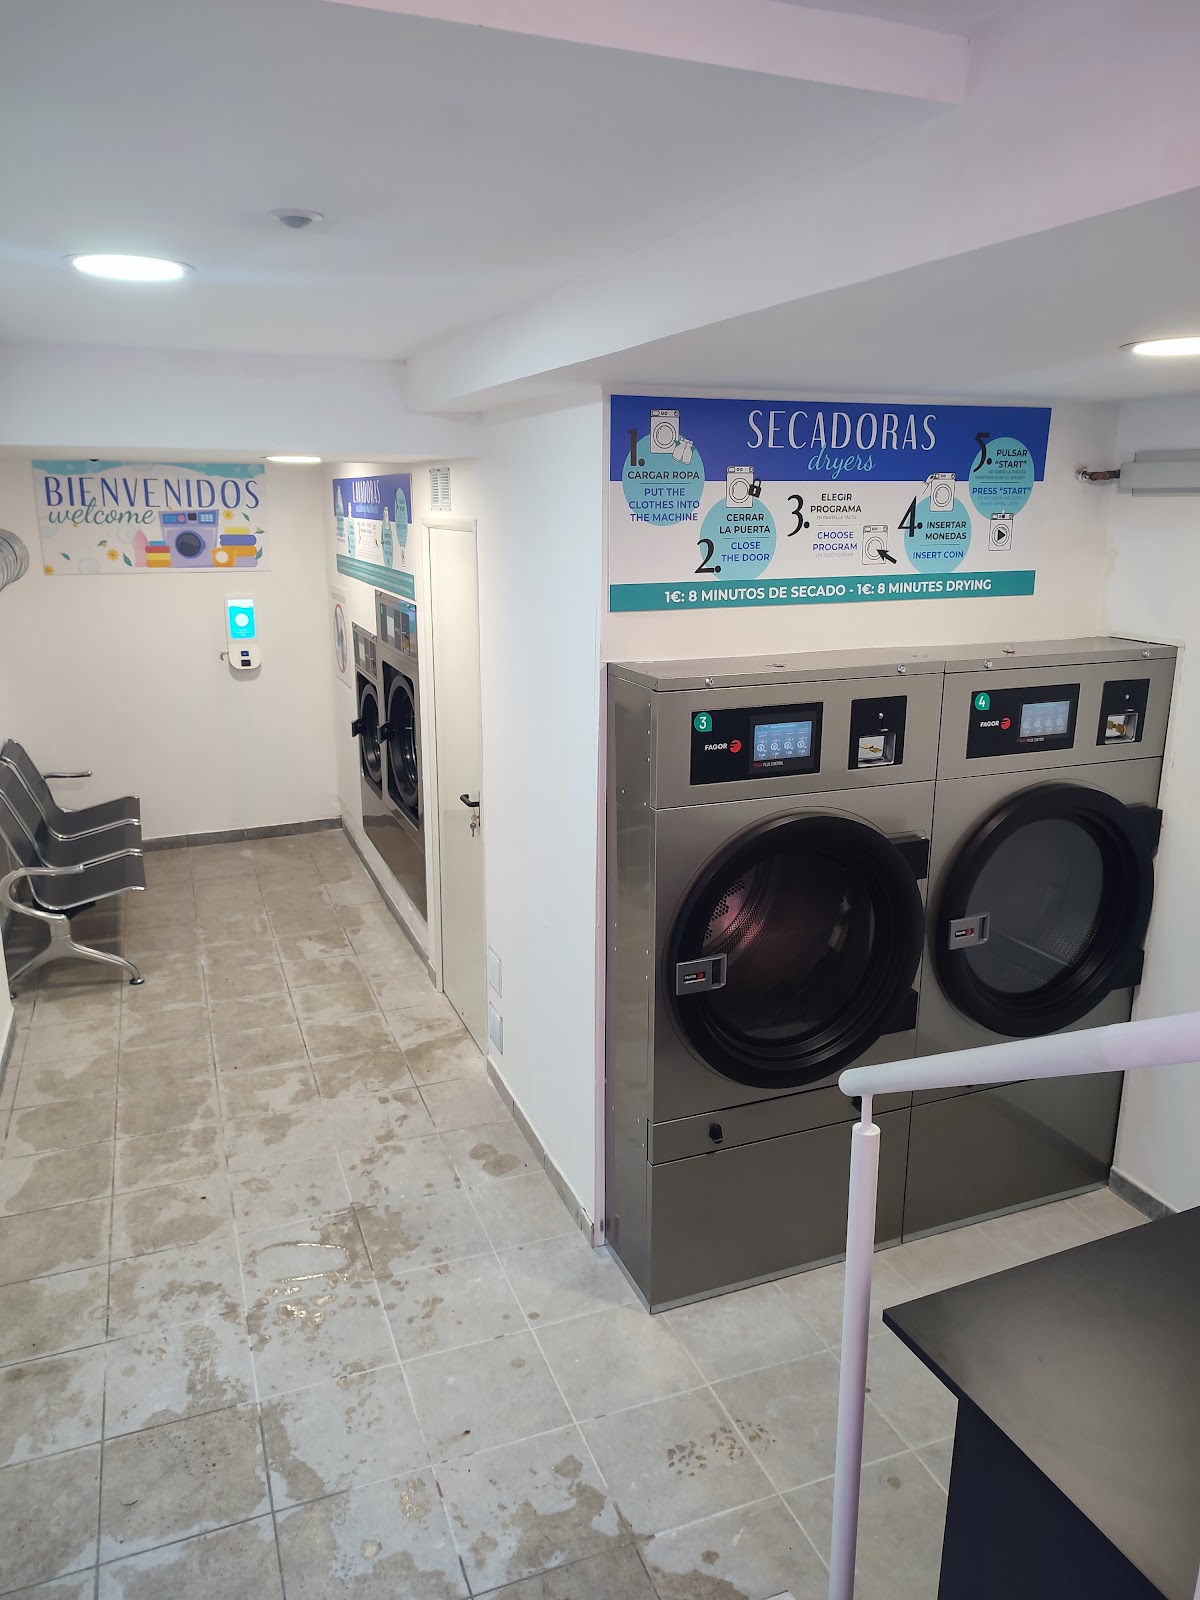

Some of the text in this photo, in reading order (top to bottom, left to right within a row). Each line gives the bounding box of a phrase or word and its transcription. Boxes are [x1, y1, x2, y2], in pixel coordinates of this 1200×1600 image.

[746, 410, 936, 450] SECADORAS
[627, 428, 646, 466] 1.
[973, 432, 992, 472] 5.
[808, 442, 876, 480] dryers
[627, 471, 700, 480] CARGAR ROPA
[44, 476, 260, 509] BIENVENIDOS
[644, 488, 685, 497] PUT THE
[629, 500, 700, 509] CLOTHES INTO
[49, 497, 156, 525] welcome
[787, 494, 810, 537] 3.
[630, 513, 698, 522] THE MACHINE
[726, 514, 764, 522] CERRAR
[898, 496, 923, 537] 4.
[926, 521, 967, 529] INSERTAR
[720, 526, 770, 534] LA PUERTA
[817, 531, 854, 539] CHOOSE
[925, 532, 967, 540] MONEDAS
[731, 542, 760, 550] CLOSE
[813, 543, 858, 551] PROGRAM
[694, 538, 722, 574] 2.
[721, 553, 770, 562] THE DOOR
[912, 551, 942, 559] INSERT
[664, 591, 685, 603] 1€:
[688, 590, 697, 602] 8
[702, 588, 765, 601] MINUTOS
[769, 587, 787, 598] DE
[790, 584, 846, 598] SECADO
[857, 583, 874, 595] 1€:
[878, 583, 885, 594] 8
[888, 581, 943, 594] MINUTES
[946, 579, 992, 592] DRYING
[978, 696, 985, 708] 4
[699, 716, 707, 729] 3
